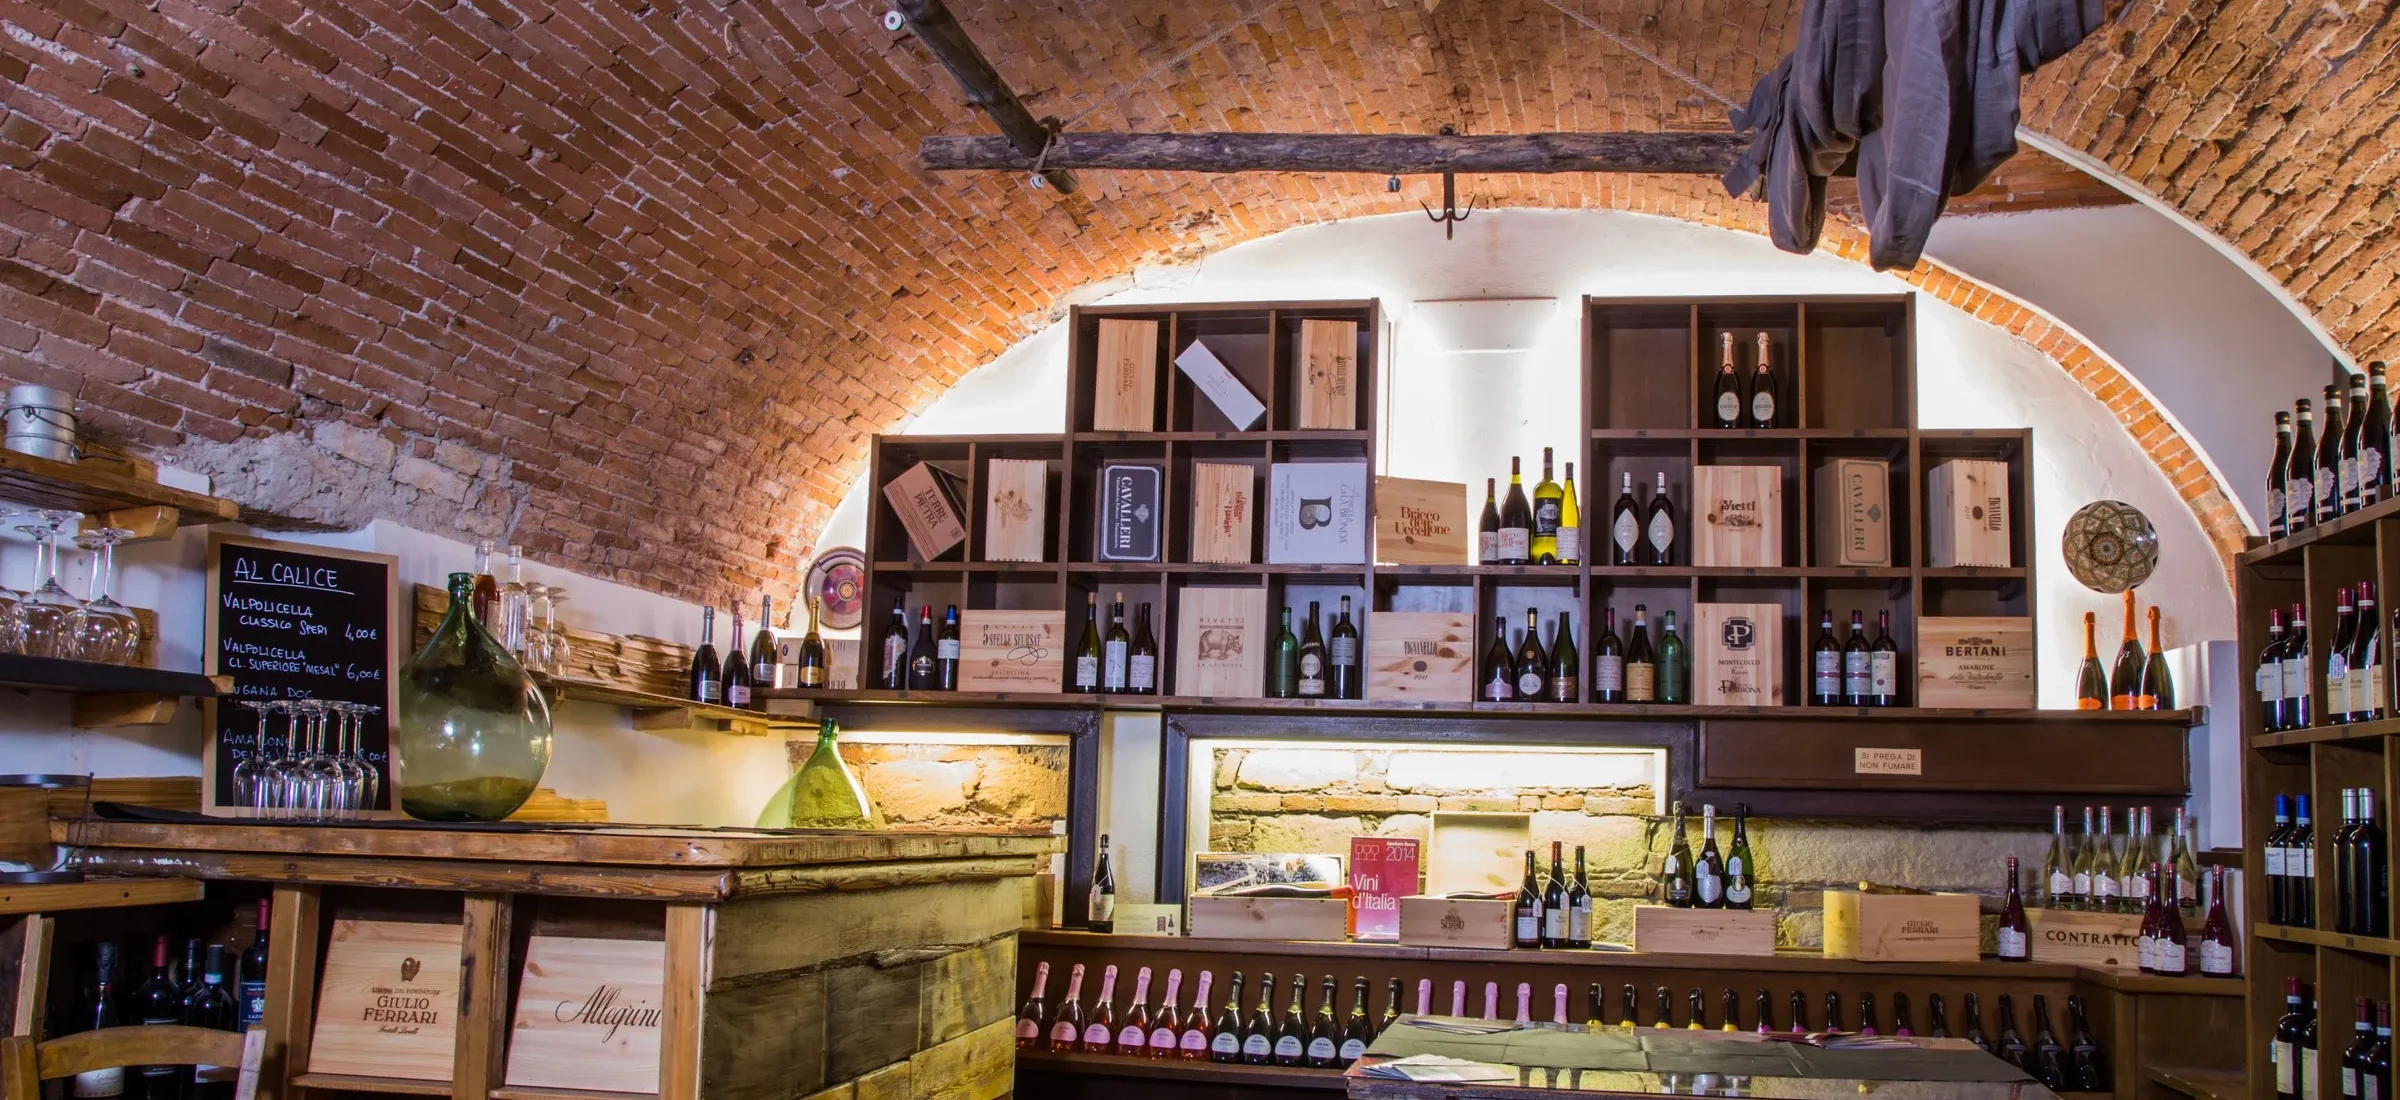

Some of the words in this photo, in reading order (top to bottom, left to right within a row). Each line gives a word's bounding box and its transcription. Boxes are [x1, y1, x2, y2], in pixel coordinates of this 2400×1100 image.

[914, 491, 938, 529] PIETRA
[925, 486, 949, 519] TERRE
[1722, 499, 1755, 511] Vietti
[1119, 476, 1133, 549] CAVALLERI
[1400, 506, 1440, 521] Bricco
[1853, 474, 1865, 551] CAVALLERI
[1395, 520, 1450, 536] Uccellone
[233, 557, 263, 581] AL
[271, 564, 338, 588] CALICE
[223, 592, 314, 617] VALPOLICELLA
[239, 615, 292, 630] CLASSICO
[299, 621, 328, 636] SPERI
[1727, 624, 1751, 645] P
[223, 638, 306, 660] VALPOLICELLA
[1945, 646, 2007, 656] BERTANI
[229, 656, 247, 669] CL.
[249, 659, 301, 674] SUPERIORE
[232, 685, 278, 697] UGANA
[287, 687, 313, 699] DOC
[1859, 761, 1879, 769] NON
[1882, 762, 1917, 770] FUMARE
[1861, 752, 1869, 760] SI
[1873, 752, 1903, 760] PREGA
[1906, 753, 1916, 761] DI
[1385, 846, 1416, 861] 2014
[1353, 873, 1379, 891] Vini
[1352, 892, 1396, 911] d'Italia
[1901, 926, 1939, 934] FERRARI
[377, 995, 430, 1010] GIULIO
[362, 1007, 439, 1024] FERRARI
[555, 985, 662, 1044] Allegrini
